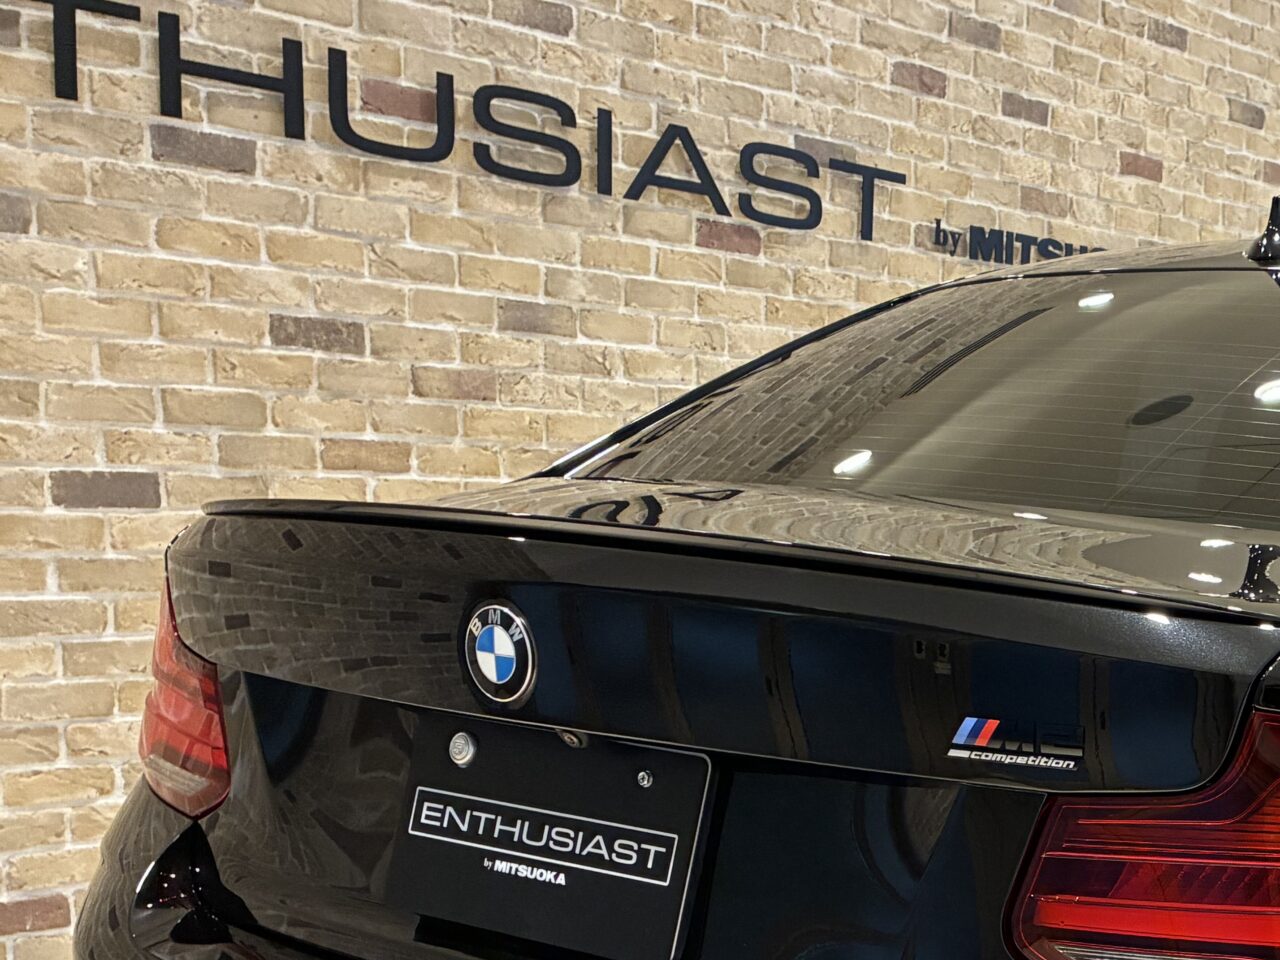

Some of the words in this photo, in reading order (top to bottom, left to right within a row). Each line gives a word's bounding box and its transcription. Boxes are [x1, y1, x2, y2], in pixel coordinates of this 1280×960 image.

[933, 218, 962, 257] by
[470, 608, 524, 642] BMW
[970, 751, 1076, 769] competition
[420, 801, 667, 869] ENTHUSIAST
[483, 857, 494, 870] by
[493, 859, 567, 885] MITSUOKA
